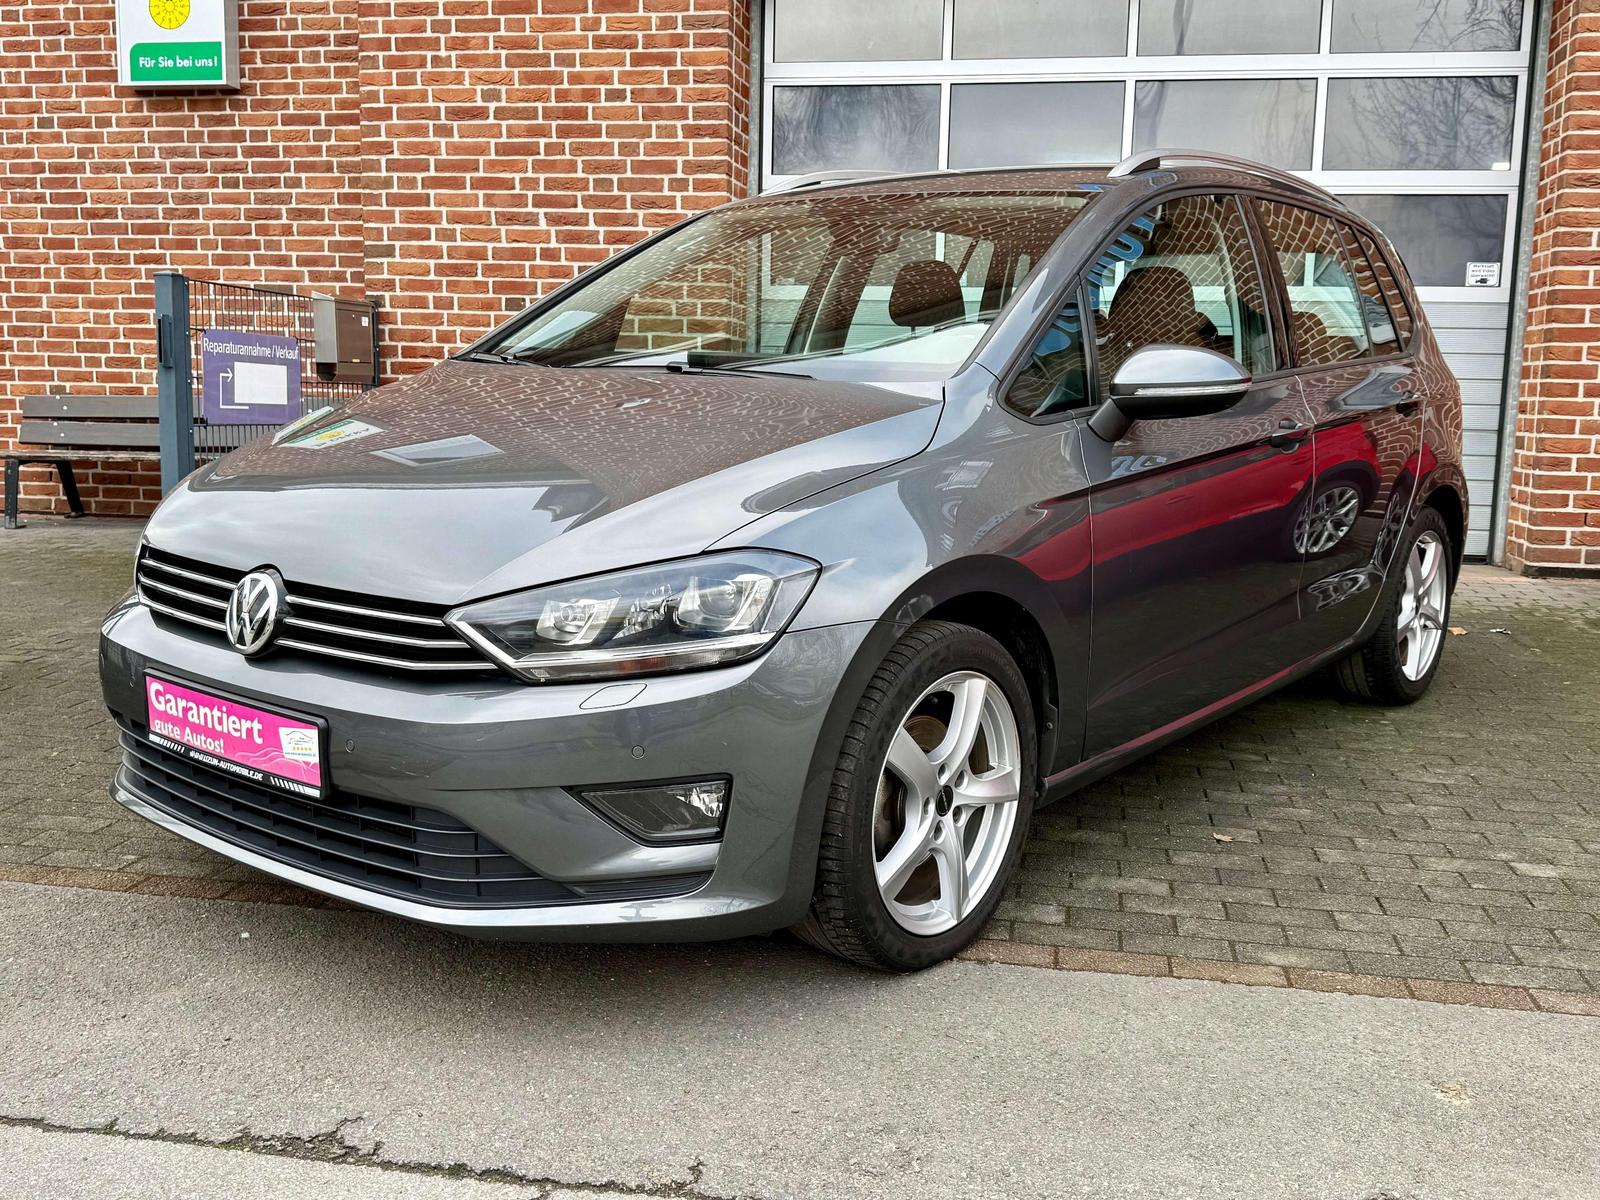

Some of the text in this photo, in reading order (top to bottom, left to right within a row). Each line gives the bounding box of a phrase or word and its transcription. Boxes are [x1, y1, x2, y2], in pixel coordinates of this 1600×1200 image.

[139, 57, 155, 67] Für
[158, 56, 173, 67] Sie
[176, 55, 193, 66] bei
[203, 337, 271, 358] Reparaturannahme
[275, 345, 299, 360] Verkauf
[226, 573, 278, 654] VW
[150, 682, 263, 744] Garantiert
[154, 719, 224, 754] gute Autos!
